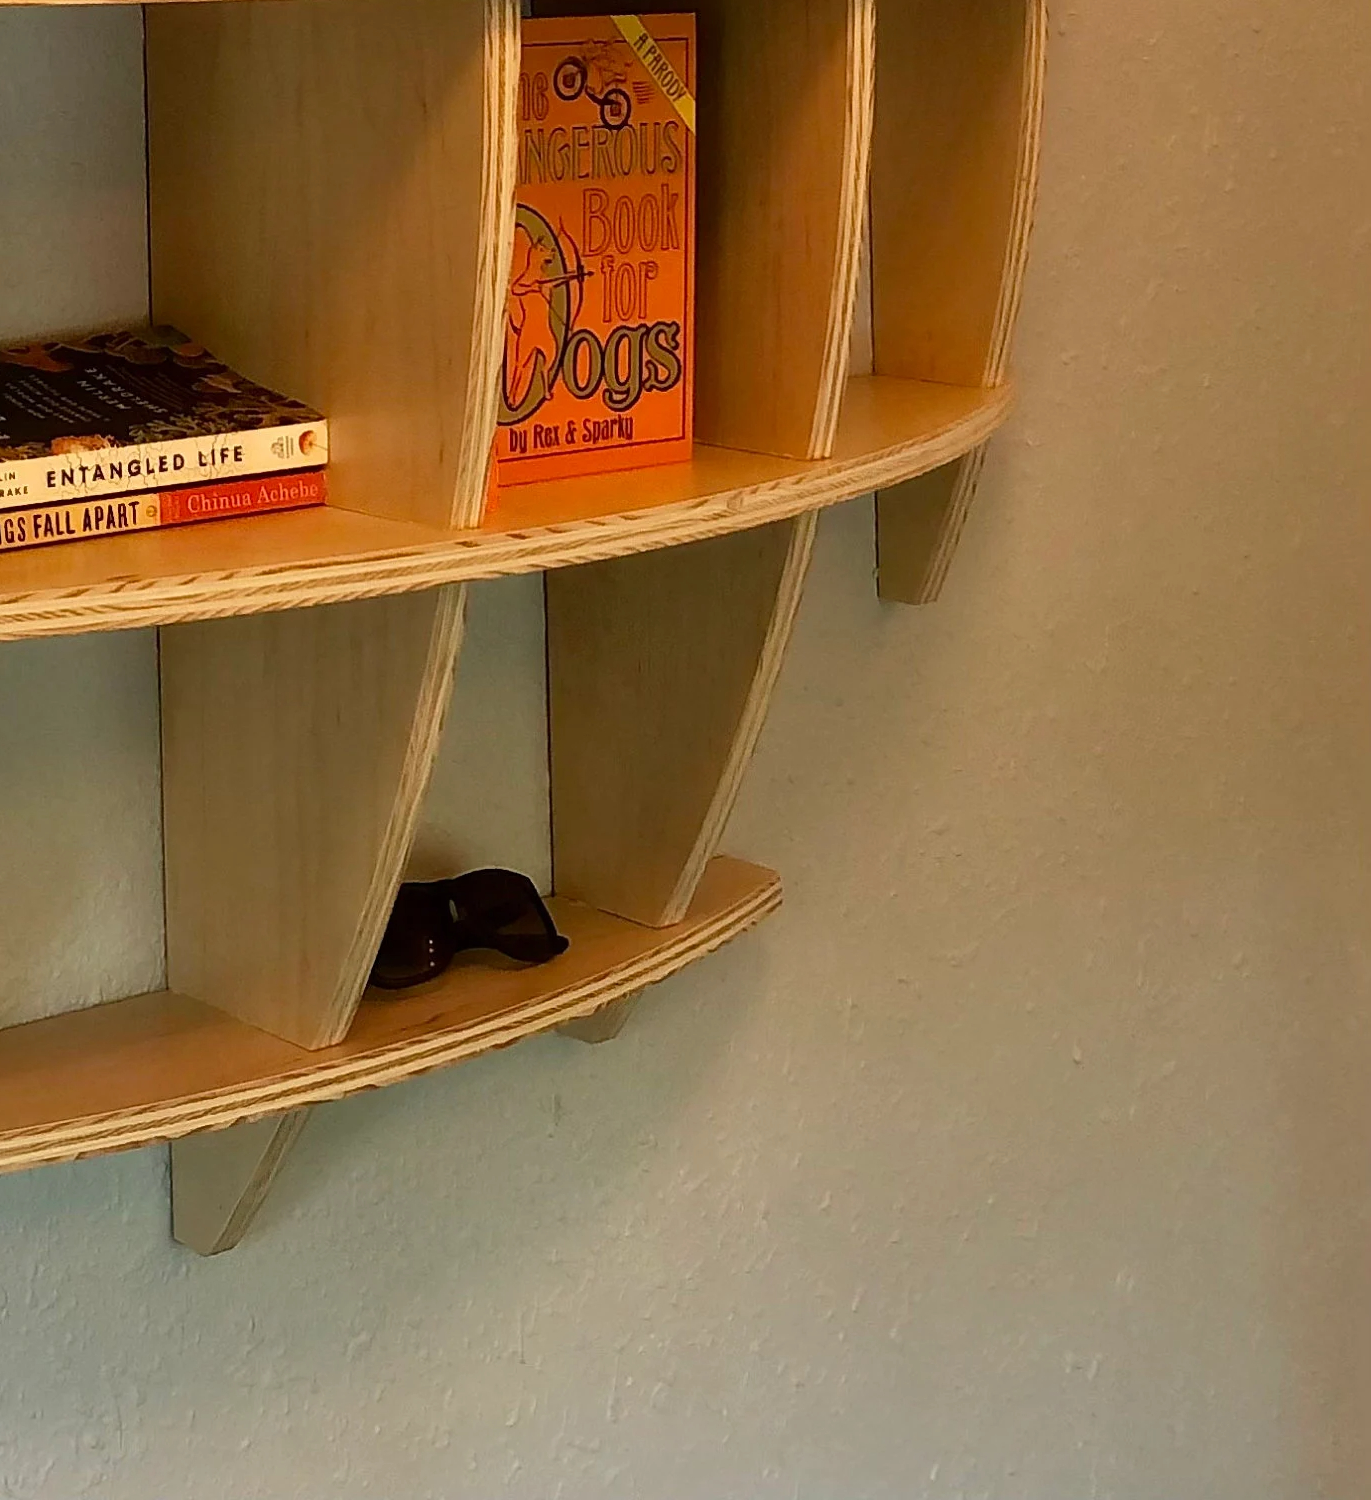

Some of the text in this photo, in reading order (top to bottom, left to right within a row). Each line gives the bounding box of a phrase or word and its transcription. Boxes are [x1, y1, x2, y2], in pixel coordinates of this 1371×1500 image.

[633, 32, 687, 102] A PARODY
[518, 120, 682, 184] NGEROUS
[582, 183, 679, 257] Book
[600, 255, 659, 323] for
[509, 414, 634, 453] by Rex & Sparky
[46, 444, 243, 488] ENTANGLED LIFE
[33, 510, 76, 539] FALL
[82, 501, 140, 532] APART
[187, 490, 253, 514] Chinua
[257, 479, 320, 505] Achebe
